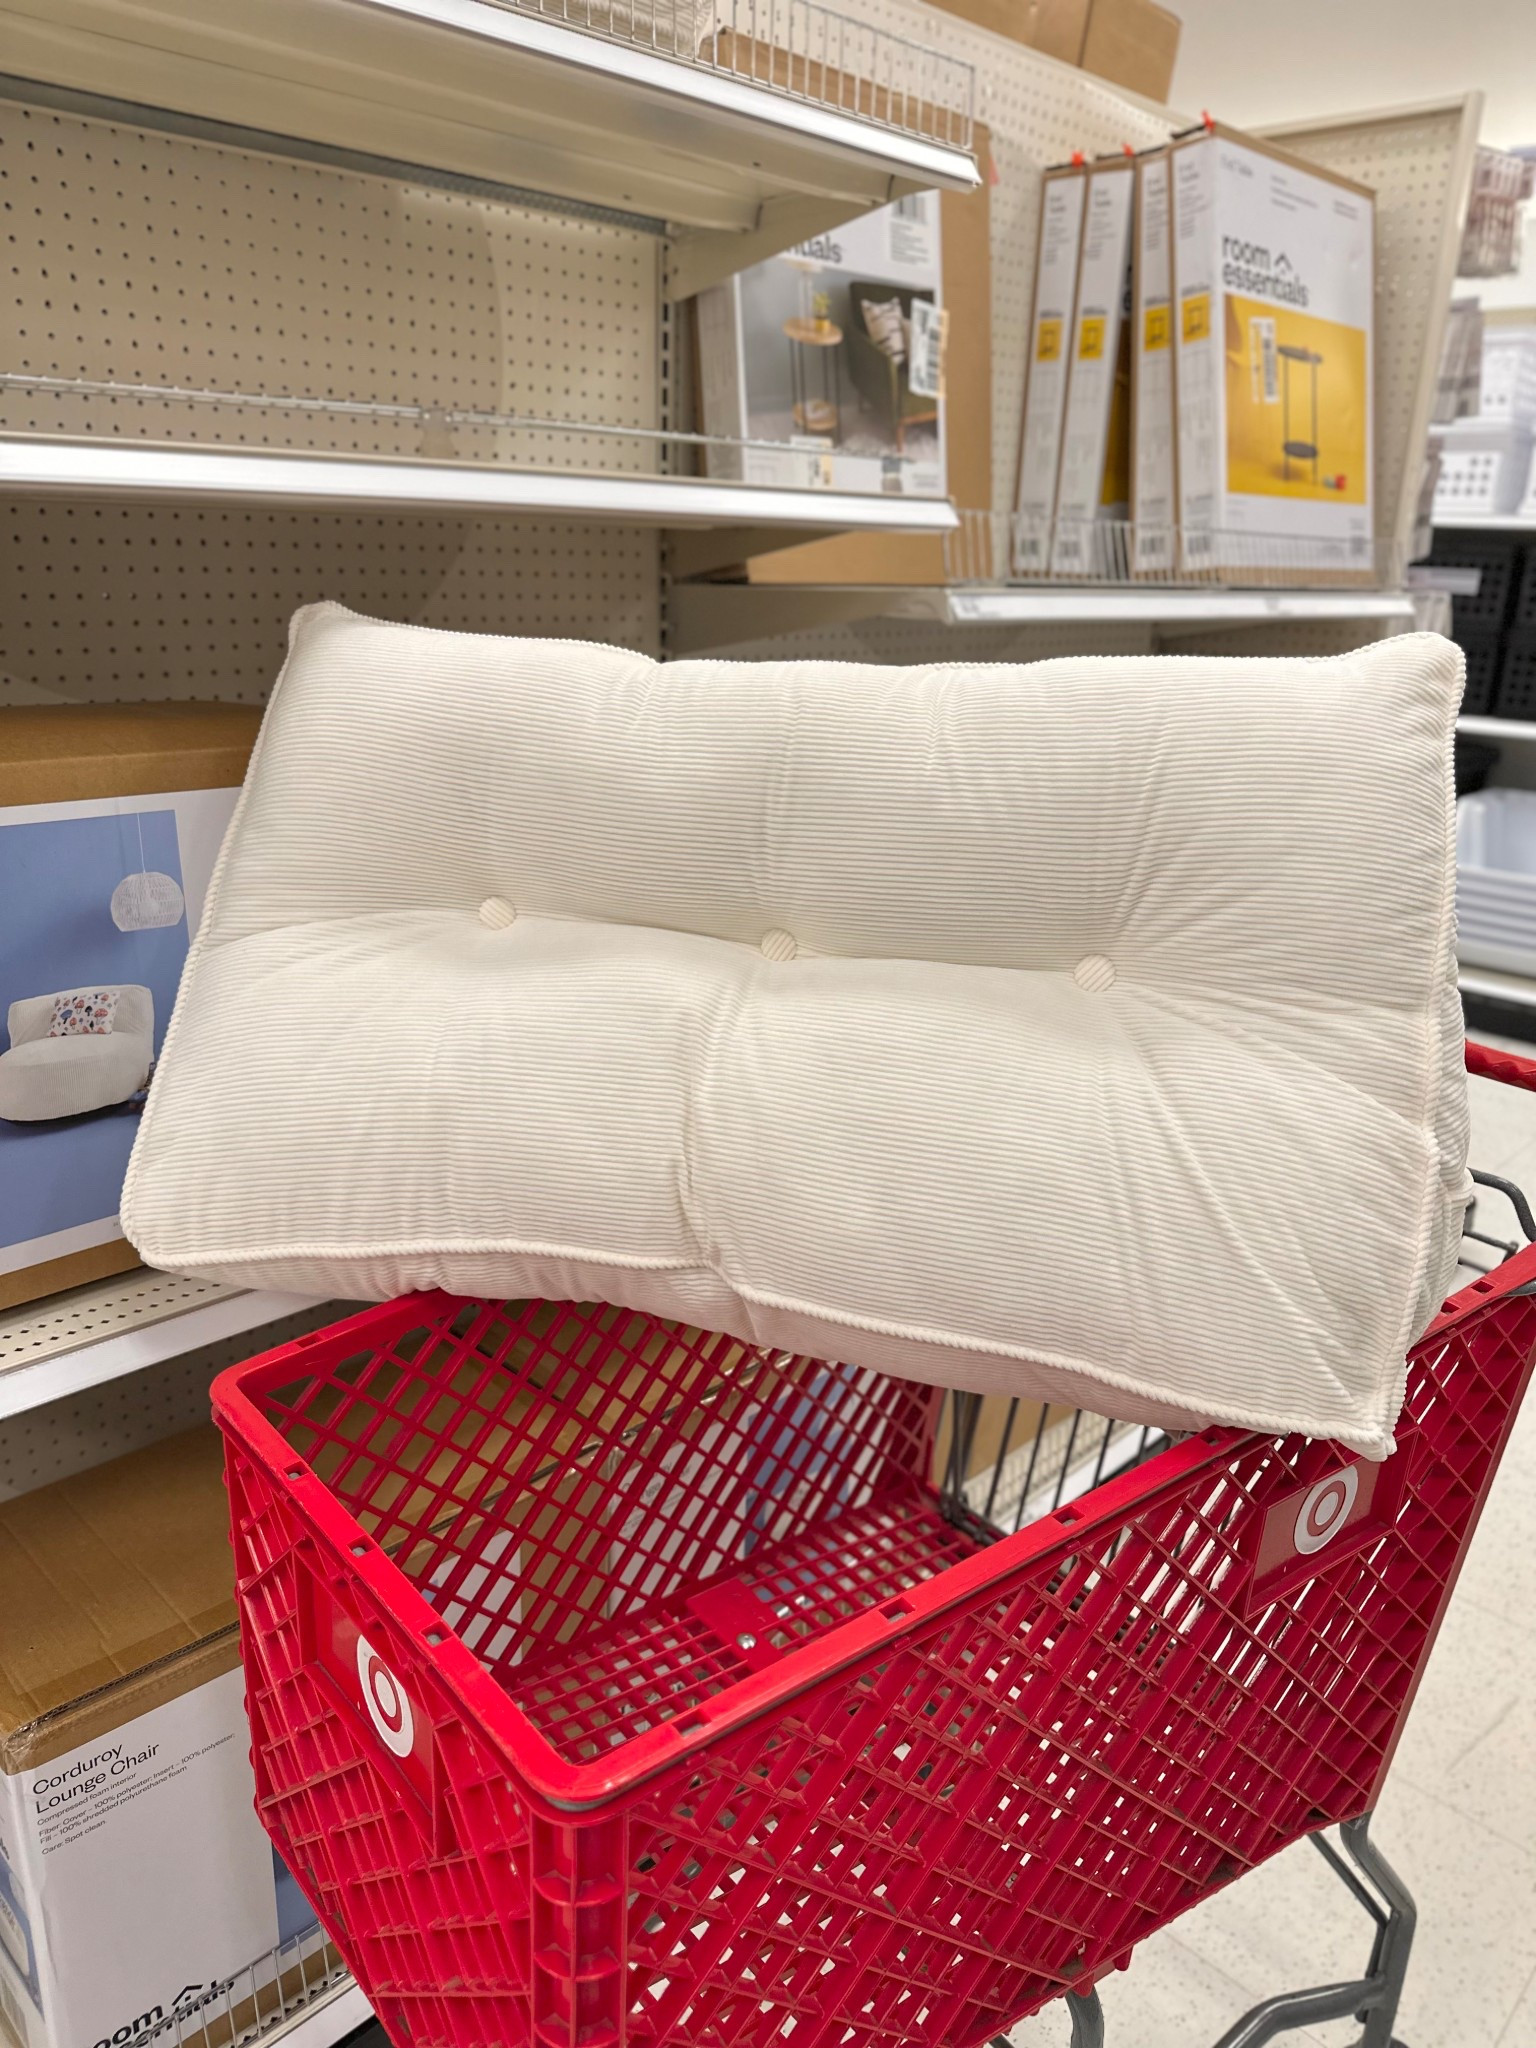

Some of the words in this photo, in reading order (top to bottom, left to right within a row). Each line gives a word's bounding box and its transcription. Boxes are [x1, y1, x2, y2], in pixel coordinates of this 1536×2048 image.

[1222, 235, 1271, 271] room
[1221, 262, 1309, 308] essentials
[32, 1744, 123, 1795] Corduroy
[35, 1772, 106, 1814] Lounge
[110, 1743, 160, 1775] Chair
[62, 1809, 87, 1825] Cover
[94, 1795, 116, 1809] 100%
[153, 1764, 174, 1780] Insert
[181, 1751, 201, 1764] 100%
[37, 1797, 89, 1825] Compressed
[89, 1787, 109, 1800] foam
[110, 1772, 137, 1790] interior
[40, 1835, 52, 1845] Fill
[59, 1821, 82, 1835] 100%
[82, 1800, 119, 1823] shredded
[119, 1776, 168, 1805] polyurethane
[168, 1765, 188, 1779] foam
[64, 1831, 84, 1845] Spot
[92, 2005, 164, 2048] oom
